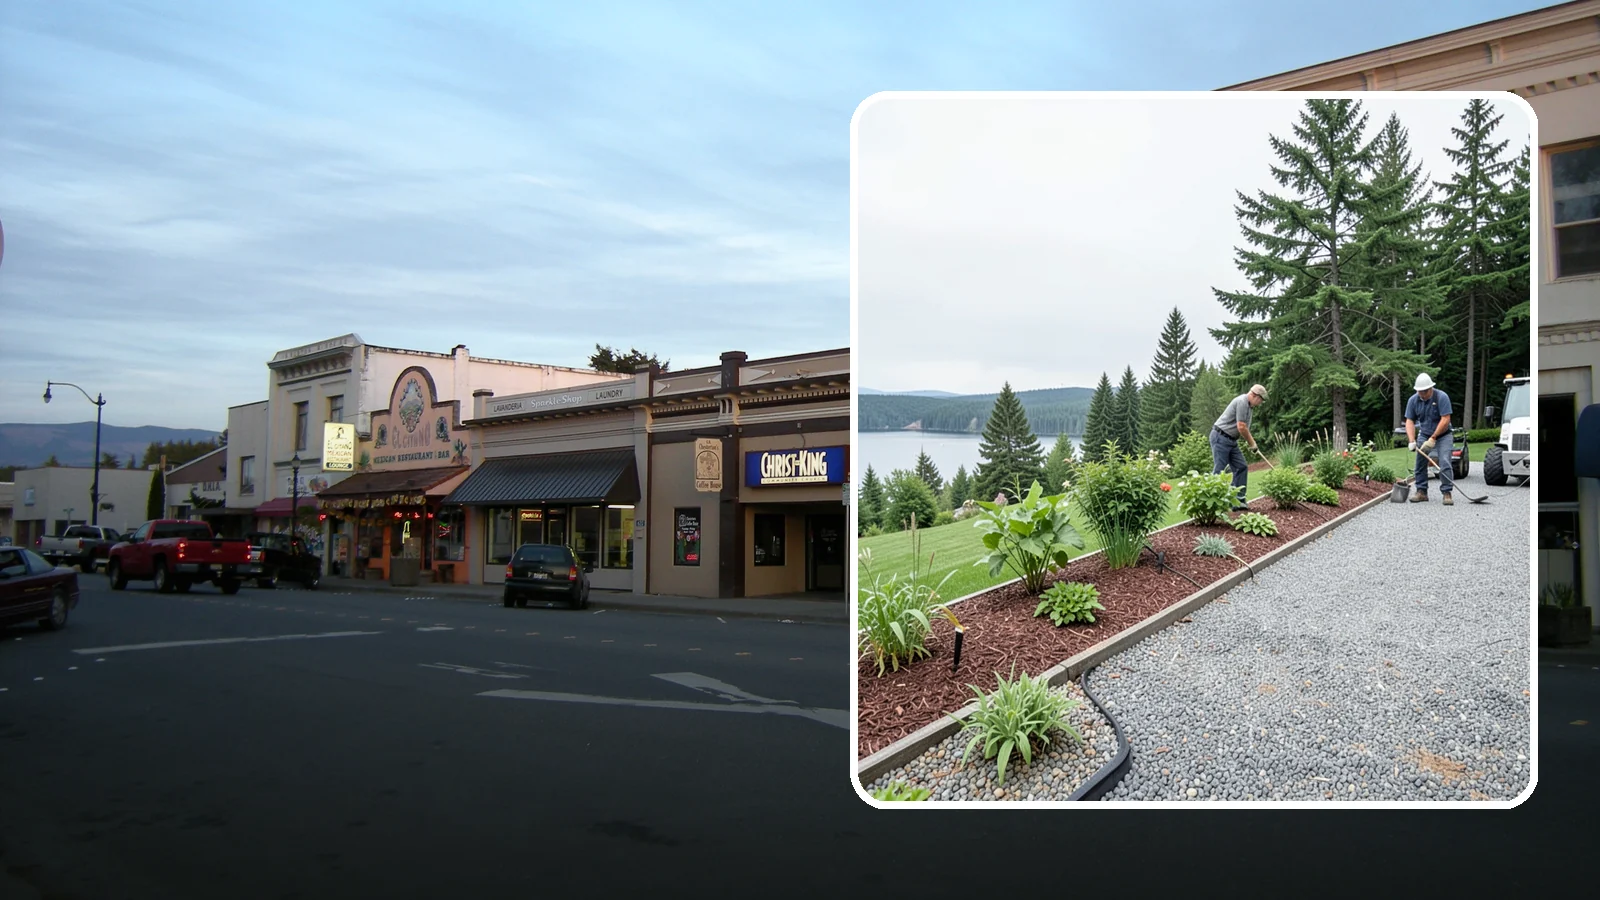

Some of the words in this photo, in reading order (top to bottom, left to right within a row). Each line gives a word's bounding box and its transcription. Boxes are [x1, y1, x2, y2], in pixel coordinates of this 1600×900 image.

[493, 402, 523, 412] LAVANDERIA
[530, 396, 561, 409] Sparkle
[561, 394, 583, 404] Shop
[595, 389, 623, 400] LAUNDRY
[374, 455, 396, 464] MEXICAN
[397, 451, 433, 462] RESTAURANT
[438, 450, 450, 459] BAR
[761, 452, 797, 478] CHRIST
[799, 450, 827, 477] KING
